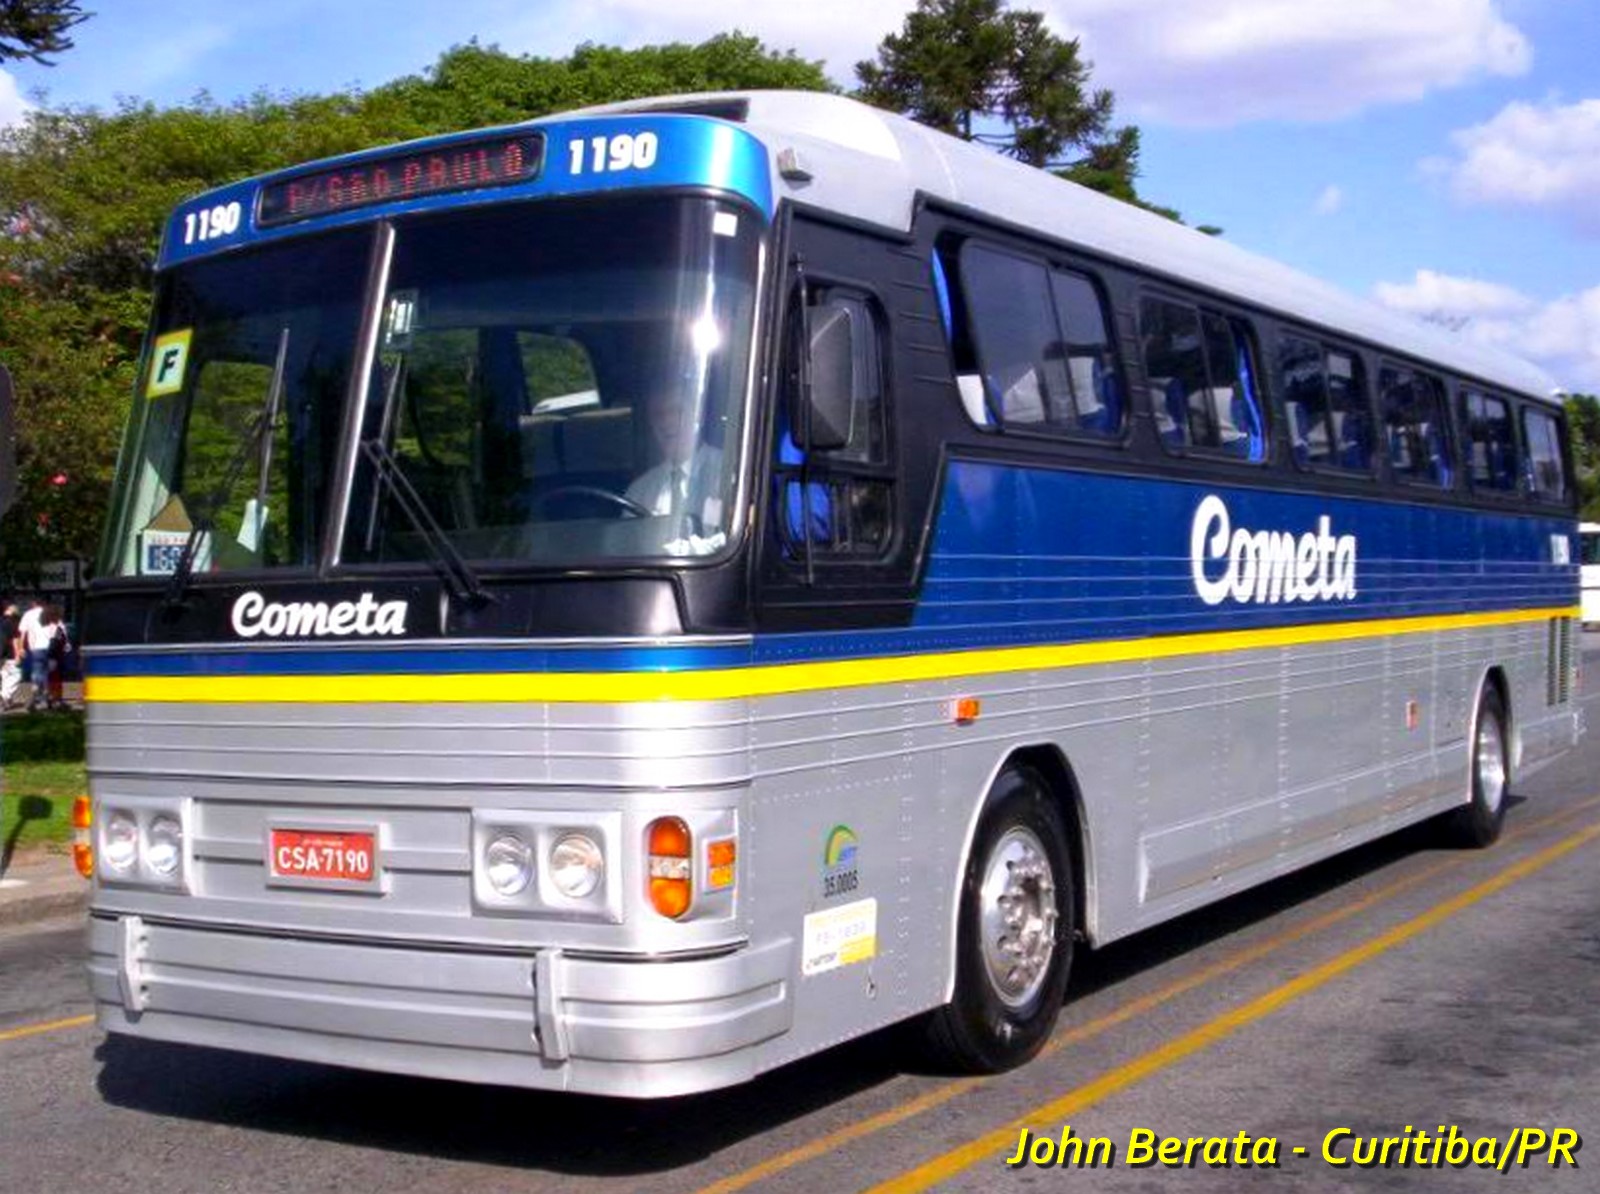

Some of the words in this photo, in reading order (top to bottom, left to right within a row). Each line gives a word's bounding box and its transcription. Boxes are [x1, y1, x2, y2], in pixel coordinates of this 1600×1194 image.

[569, 131, 658, 175] 1190
[184, 201, 242, 245] 1190
[157, 348, 179, 383] F
[1188, 494, 1359, 606] Cometa
[231, 590, 408, 637] Cometa
